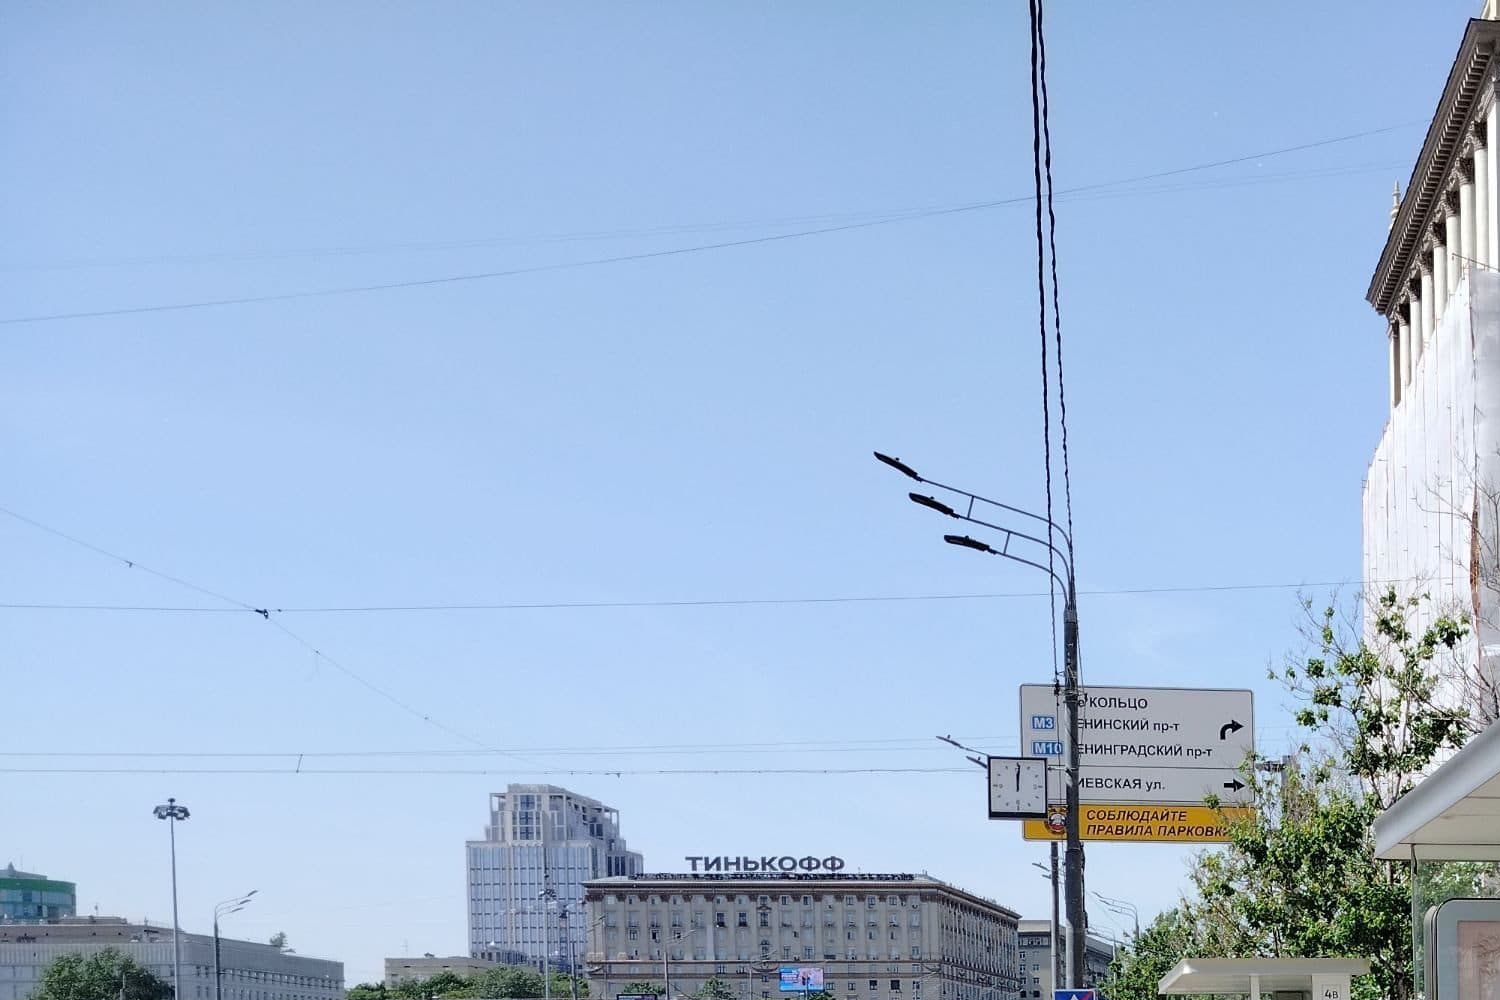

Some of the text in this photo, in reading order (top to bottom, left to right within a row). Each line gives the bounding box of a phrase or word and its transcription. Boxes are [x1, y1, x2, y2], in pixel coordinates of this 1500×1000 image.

[1089, 696, 1148, 710] КОЛЬЦО
[1033, 717, 1180, 733] М3 ЕНИНСКИЙ пр-т
[1034, 742, 1213, 759] М10 ЕНИНГРАДСКИЙ пр-т
[1145, 780, 1166, 792] ул.
[1086, 808, 1188, 824] СОБЛЮДАЙТЕ
[1086, 825, 1153, 836] ПРАВИЛА
[685, 856, 845, 872] ТИНЬКОФФ
